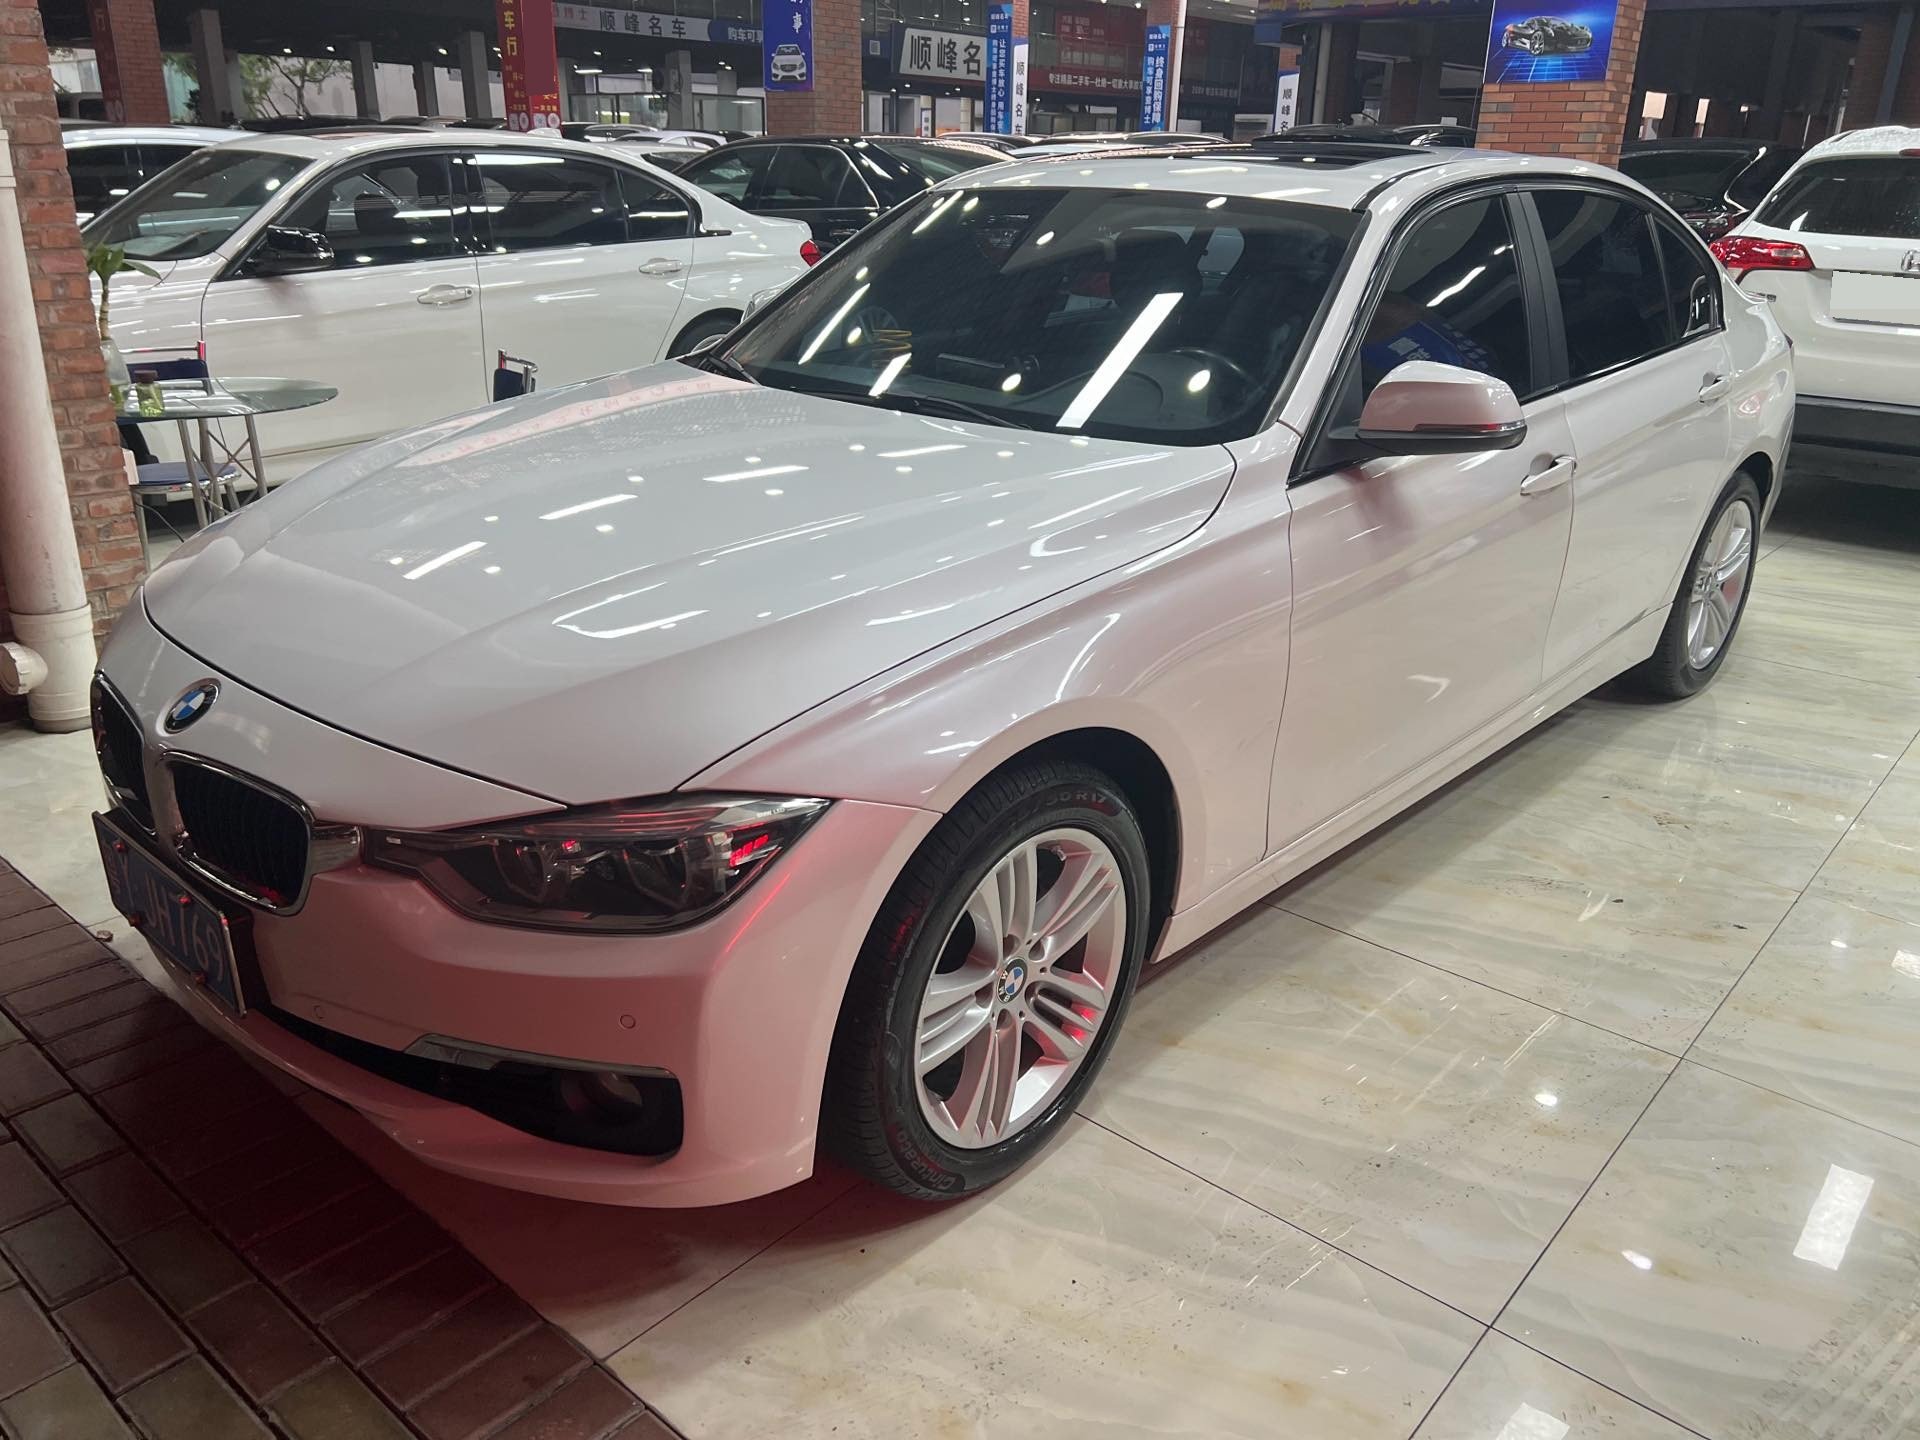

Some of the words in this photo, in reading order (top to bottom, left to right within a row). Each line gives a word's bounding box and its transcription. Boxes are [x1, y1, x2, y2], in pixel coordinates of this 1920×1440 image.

[600, 10, 686, 38] 顺峰名车
[909, 35, 981, 76] 顺峰名
